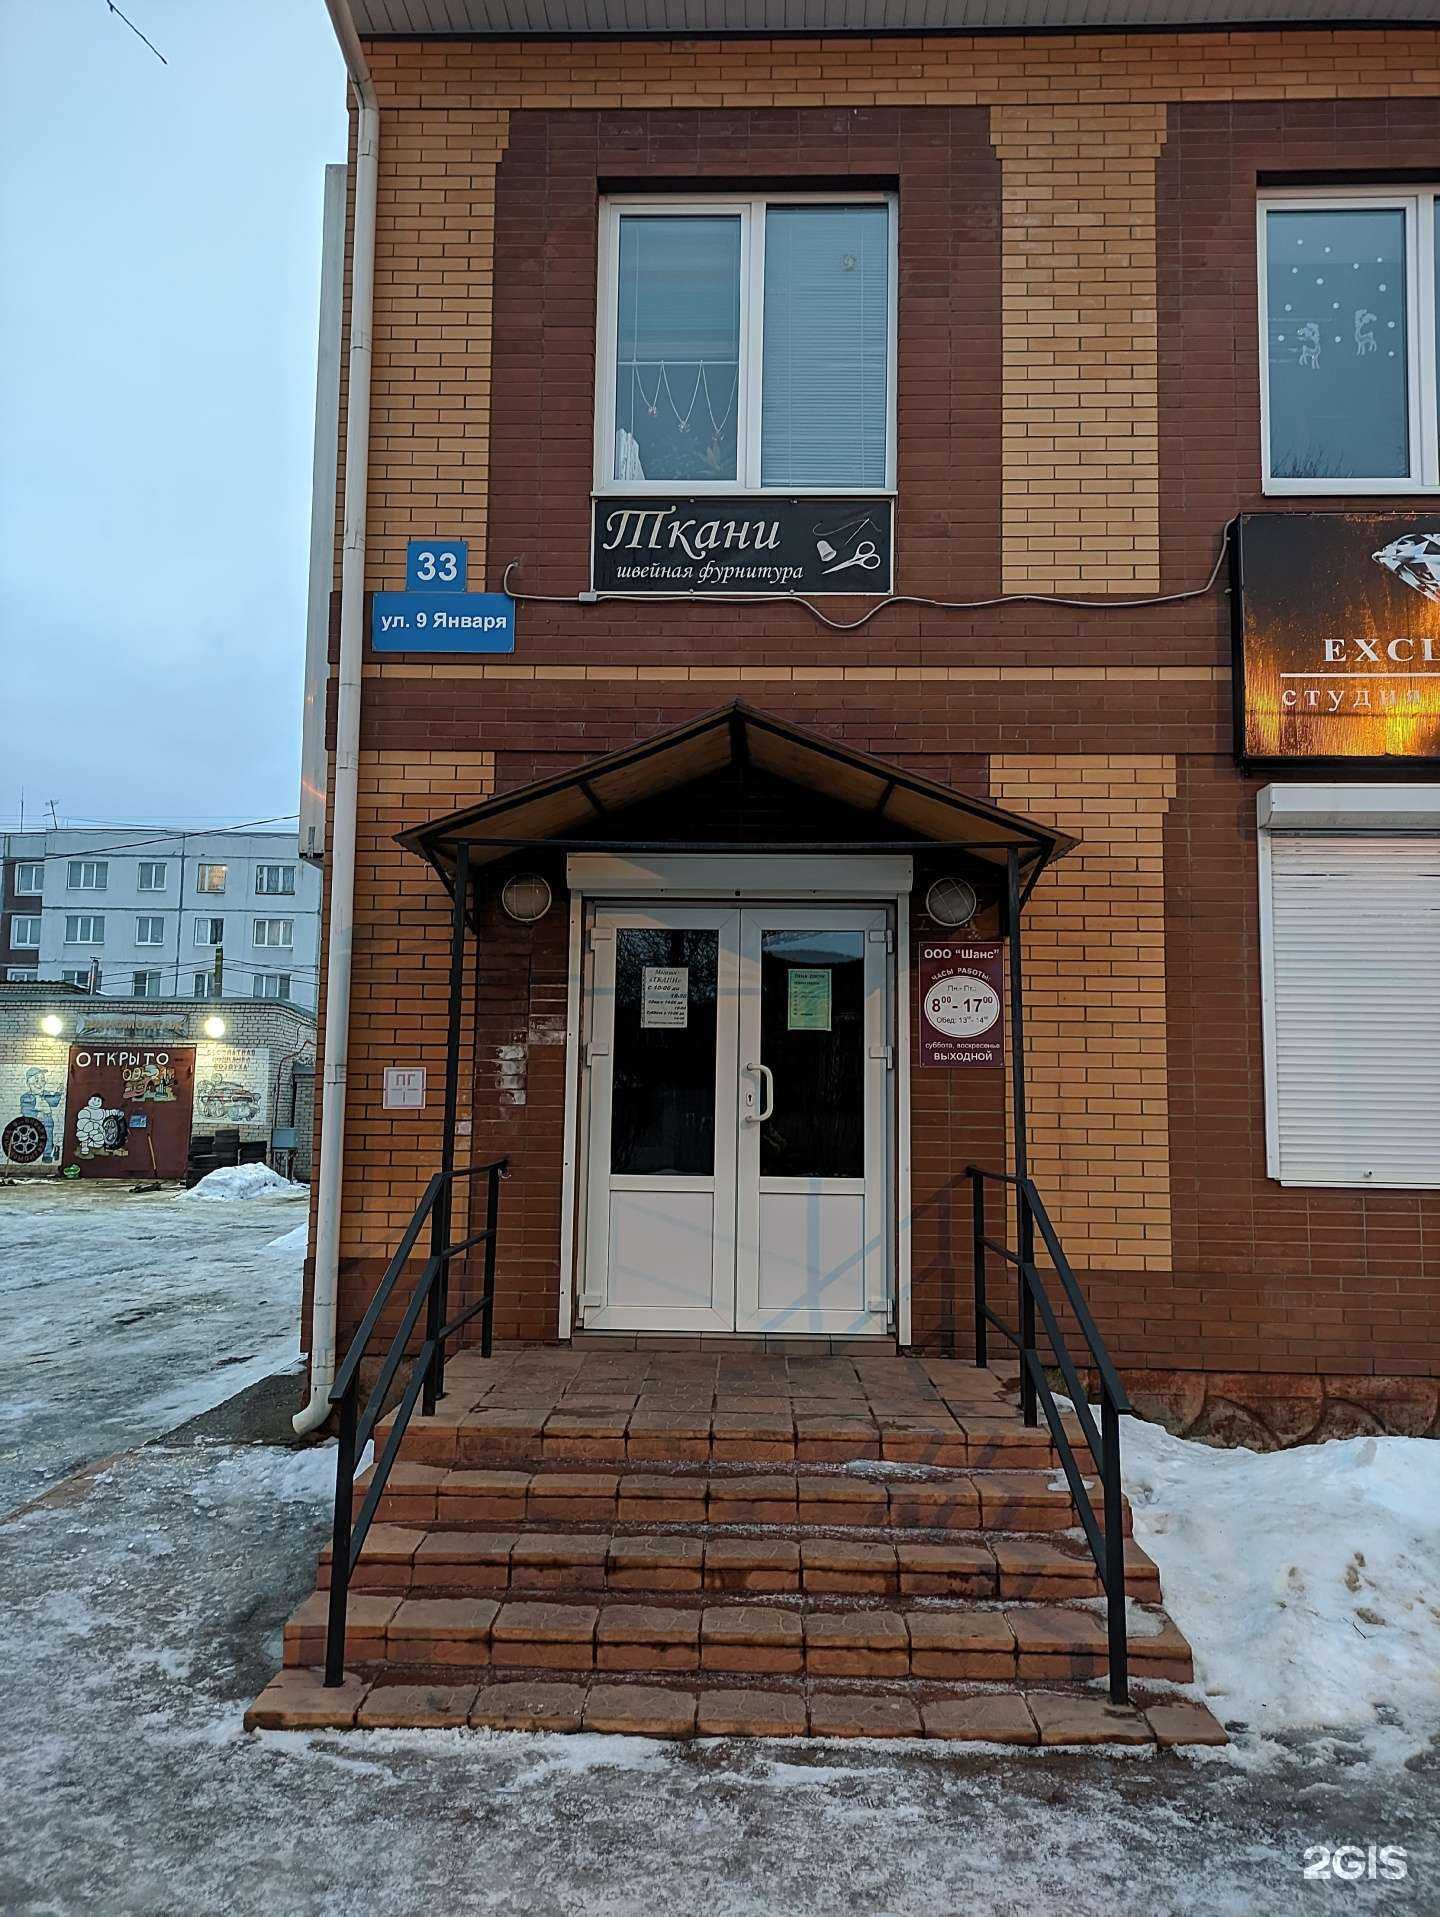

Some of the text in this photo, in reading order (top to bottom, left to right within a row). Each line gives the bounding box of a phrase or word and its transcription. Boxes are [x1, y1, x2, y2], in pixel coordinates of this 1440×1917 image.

[602, 505, 781, 560] Ткани
[416, 552, 458, 581] 33
[616, 560, 804, 585] швейная фурнитура
[381, 612, 507, 632] ул. 9 Января
[1281, 688, 1423, 712] студия
[924, 948, 952, 960] ООО
[931, 968, 954, 981] ЧАСЫ
[76, 1052, 169, 1067] ОТКРЫТО
[933, 1050, 993, 1061] ВЫХОДНОЙ
[396, 1073, 416, 1086] ПГ
